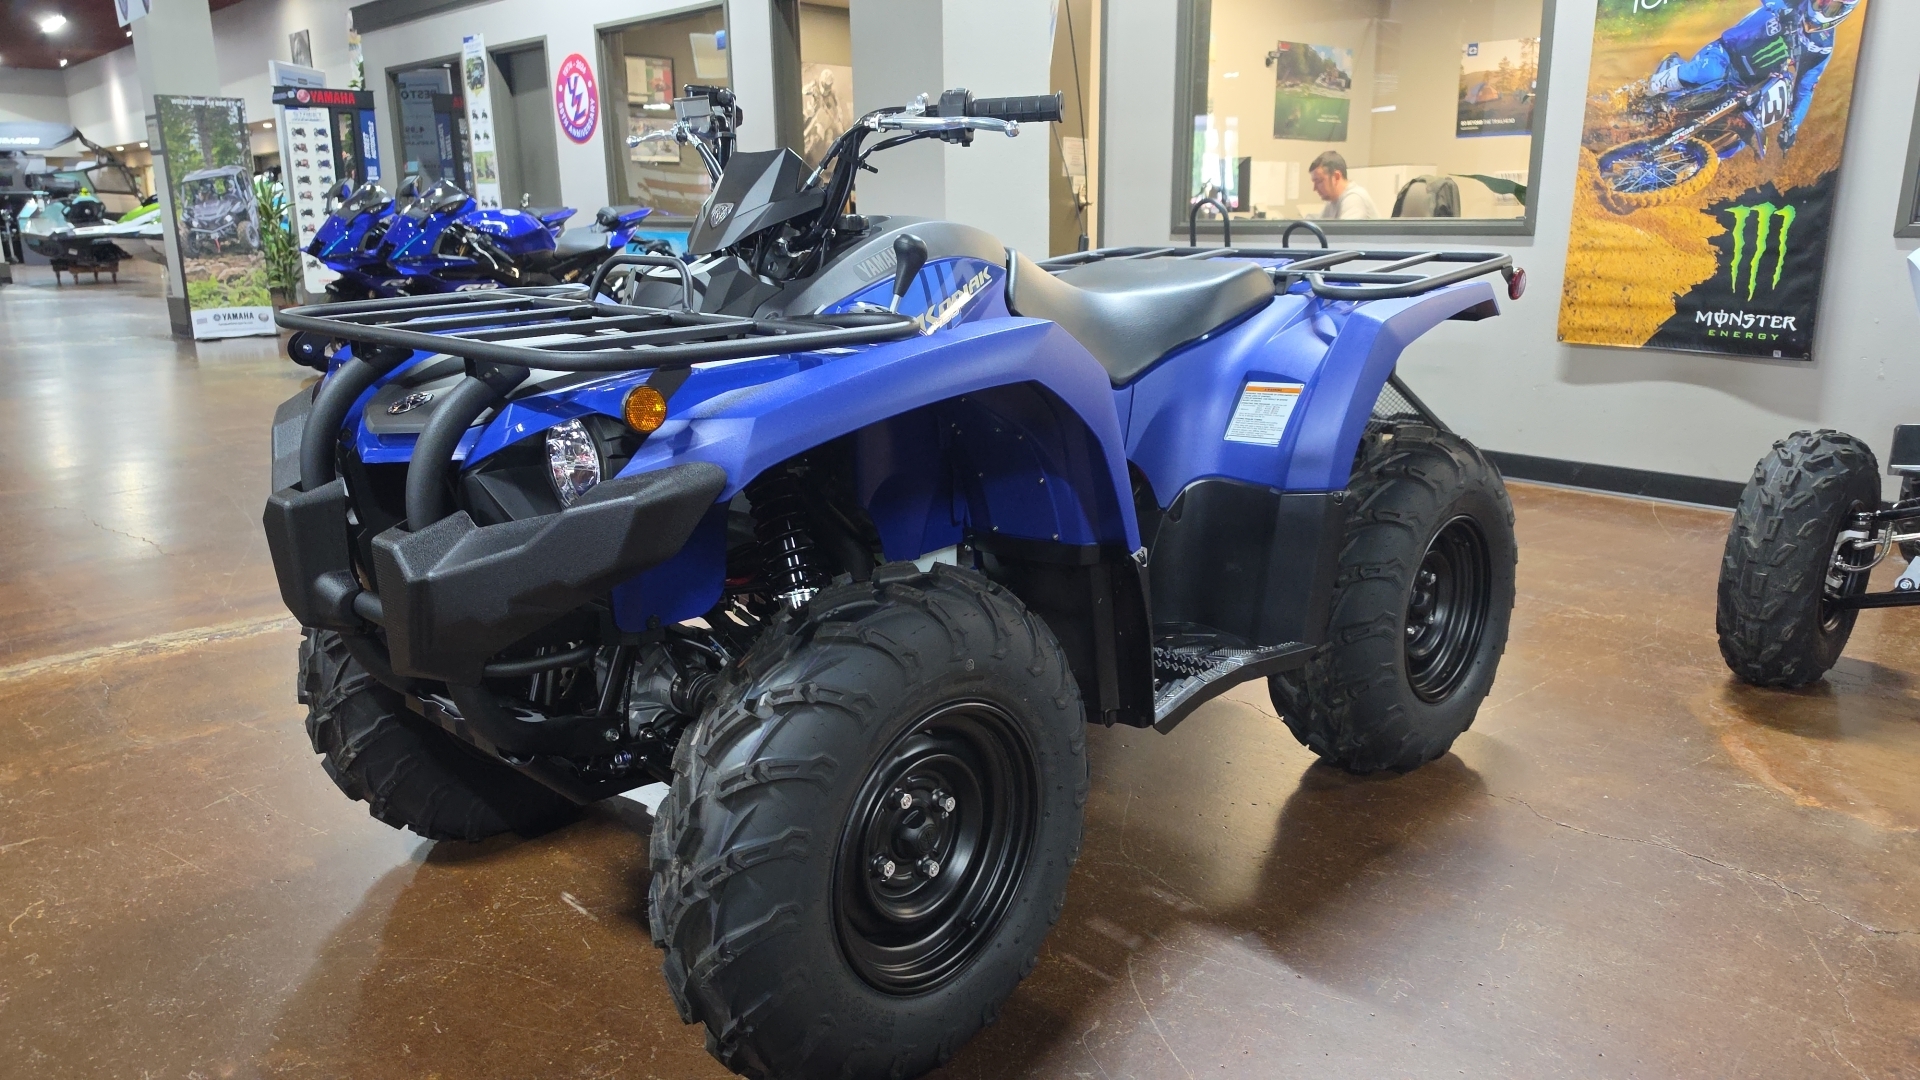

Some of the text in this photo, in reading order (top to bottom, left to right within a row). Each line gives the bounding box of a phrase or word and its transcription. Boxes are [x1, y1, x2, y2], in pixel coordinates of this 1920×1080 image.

[310, 91, 356, 104] YAMAHA
[1763, 84, 1786, 126] 3
[568, 98, 595, 138] ANNIVERSARY
[918, 266, 992, 332] KODIAK
[222, 312, 255, 321] YAMAHA
[1708, 329, 1779, 340] ENERGY
